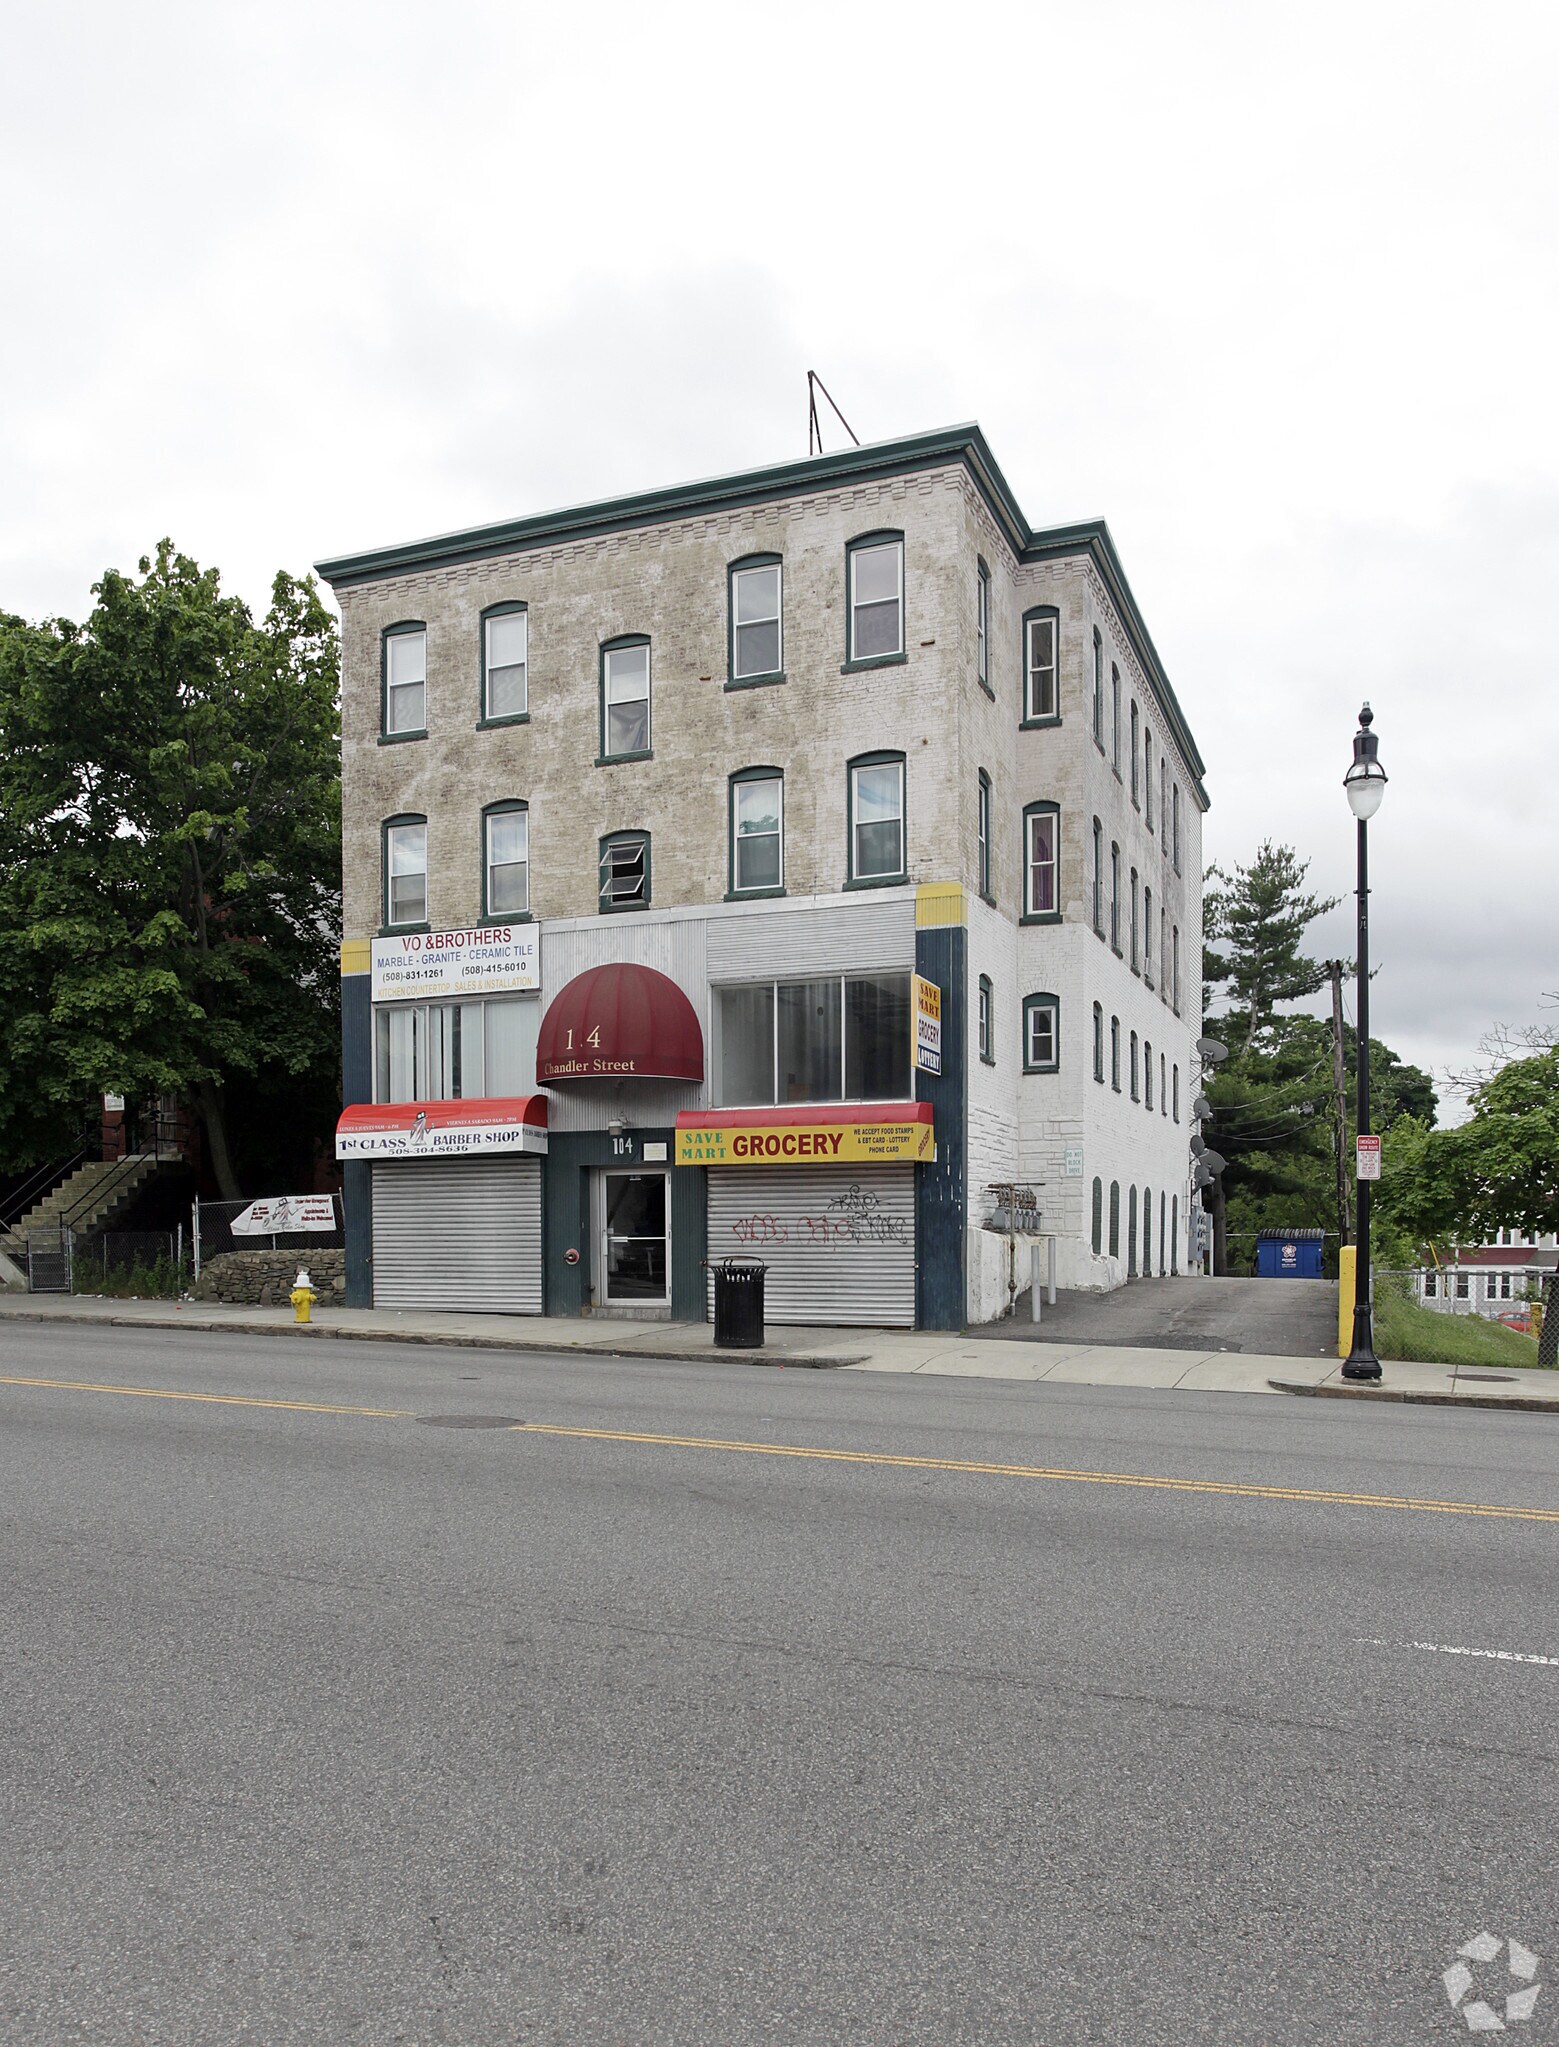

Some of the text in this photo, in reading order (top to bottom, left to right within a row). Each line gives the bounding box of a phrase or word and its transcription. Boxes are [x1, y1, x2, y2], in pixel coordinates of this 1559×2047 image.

[402, 928, 512, 951] VO &BROTHERS
[377, 955, 414, 968] MARBLE
[421, 951, 461, 965] GRANITE
[469, 947, 511, 960] CERAMIC
[513, 944, 533, 956] TILE
[382, 969, 443, 983] (508)-831-1261
[461, 961, 526, 977] (508)-415-6010
[377, 976, 532, 998] KITCHEN COUNTERTOP SALES & INSTALLATION
[920, 982, 938, 1001] SAVE
[918, 996, 939, 1017] MART
[918, 1019, 939, 1045] GROCERY
[545, 1058, 635, 1075] Chandler Street
[918, 1048, 940, 1070] LOTTERY
[339, 1139, 357, 1150] 1st
[360, 1138, 407, 1150] CLASS
[433, 1133, 481, 1146] BARBER
[485, 1130, 520, 1143] SHOP
[612, 1137, 633, 1155] 104
[685, 1133, 723, 1144] SAVE
[732, 1133, 843, 1157] GROCERY
[388, 1144, 468, 1155] 508-304-8636
[681, 1147, 726, 1159] MART
